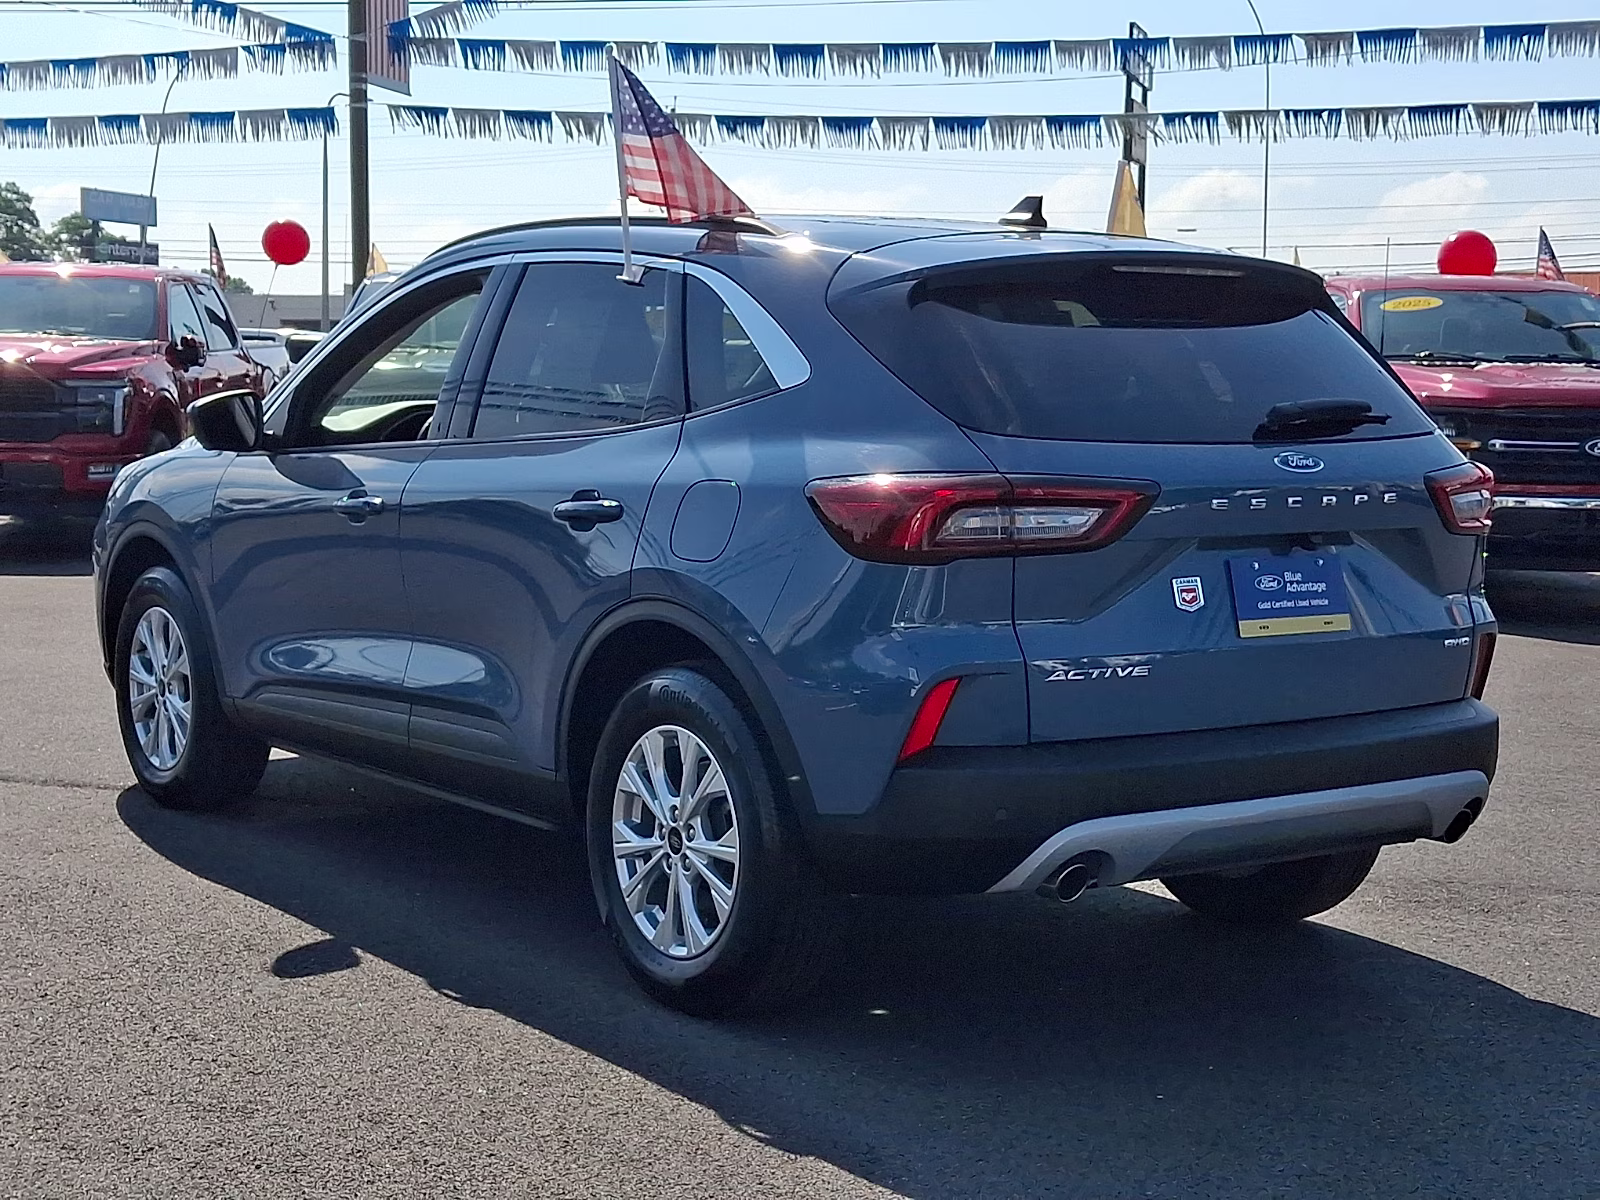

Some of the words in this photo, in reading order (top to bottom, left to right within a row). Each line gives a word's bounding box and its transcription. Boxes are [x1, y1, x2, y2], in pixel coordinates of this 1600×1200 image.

[99, 242, 157, 260] enterpse
[1210, 492, 1398, 510] ESCAPE
[1284, 571, 1302, 582] Blue
[1286, 582, 1327, 593] Advantage
[1257, 601, 1271, 610] Gold
[1272, 600, 1295, 609] Certified
[1295, 599, 1310, 607] Used
[1310, 598, 1329, 607] Vehicle
[1045, 665, 1153, 682] ACTIVE
